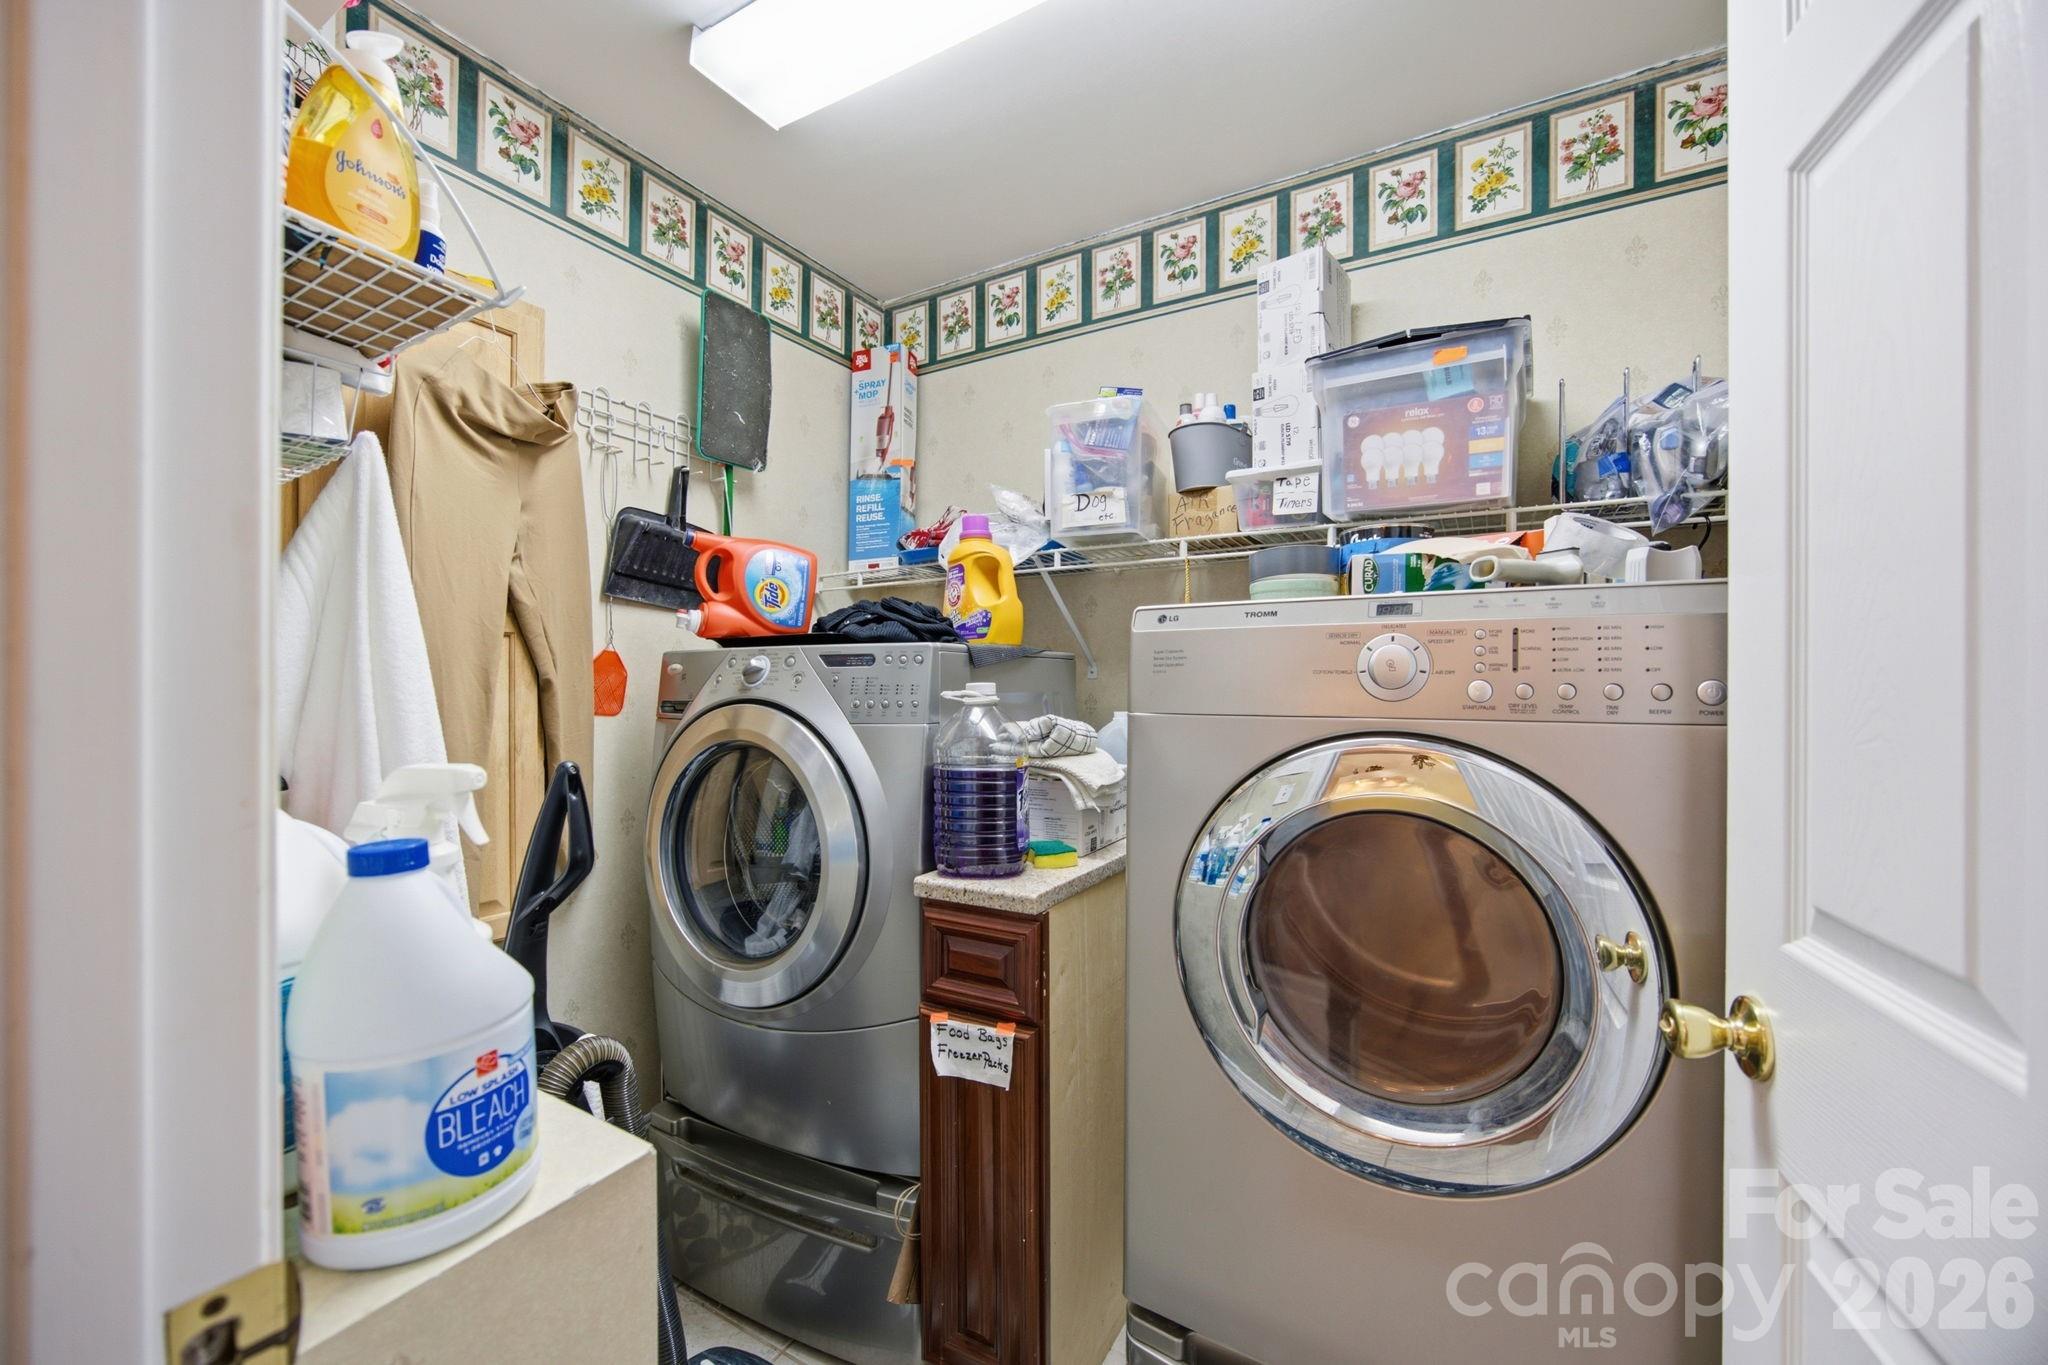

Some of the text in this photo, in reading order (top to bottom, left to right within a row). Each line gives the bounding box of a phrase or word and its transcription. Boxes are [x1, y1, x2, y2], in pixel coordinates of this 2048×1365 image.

[858, 378, 886, 391] SPRAY
[858, 390, 879, 400] MOP
[1405, 406, 1430, 418] relax
[1275, 475, 1311, 489] Tape
[856, 493, 883, 503] RINSE.
[1071, 493, 1107, 511] Dog
[1278, 497, 1312, 509] Timers
[856, 503, 885, 513] REFILL.
[856, 512, 885, 523] REUSE.
[1364, 559, 1374, 592] CURAD
[764, 582, 782, 609] Tide
[1244, 610, 1278, 618] TROMM
[936, 1023, 1008, 1049] Food Bags
[937, 1043, 1009, 1073] Freezer Packs
[449, 1064, 519, 1105] LOW SPLASH
[437, 1075, 525, 1149] BLEACH
